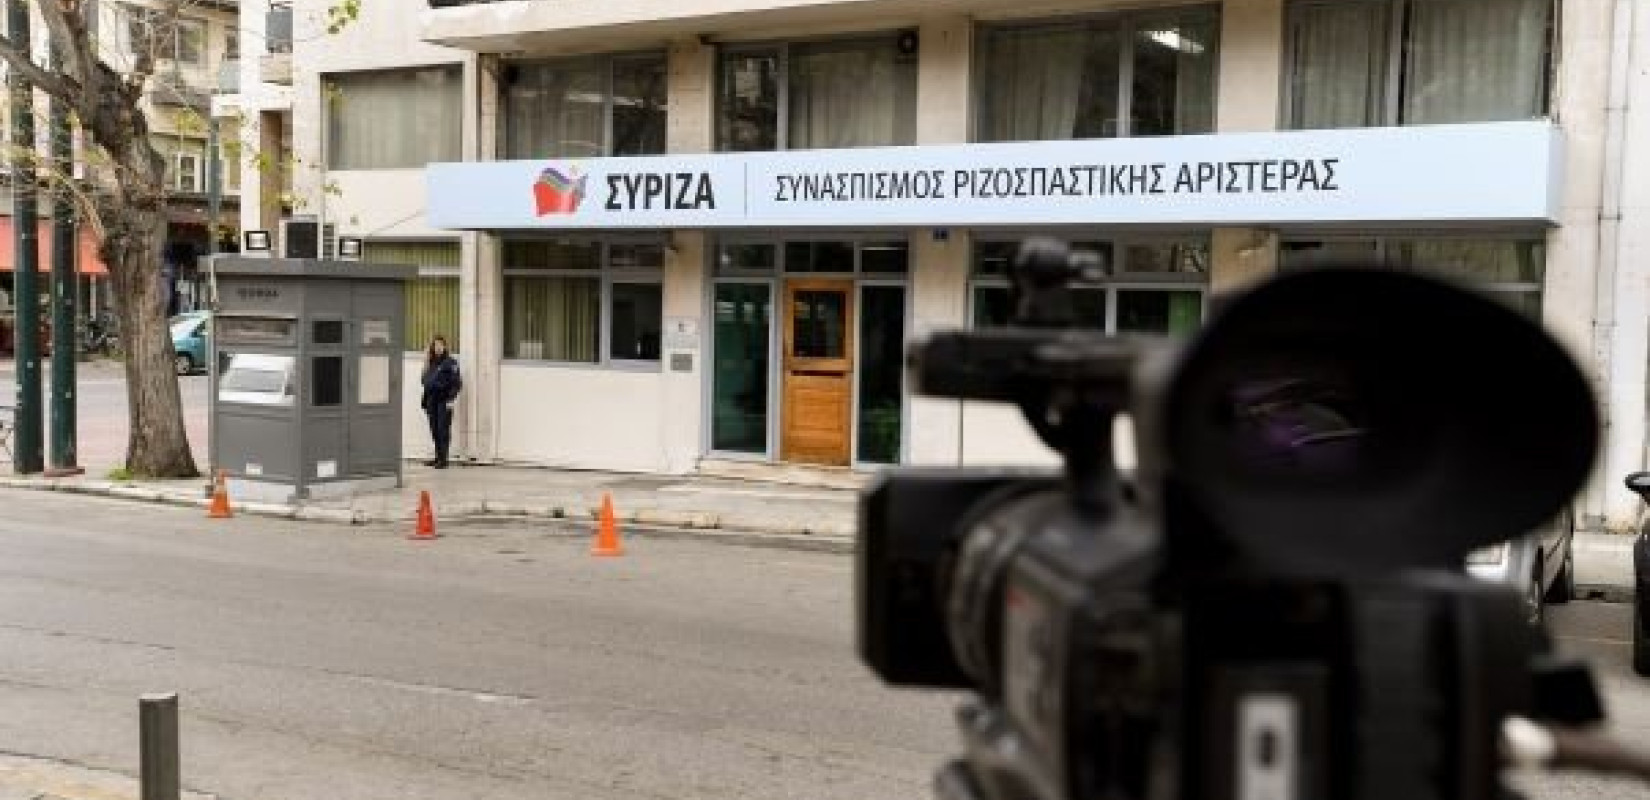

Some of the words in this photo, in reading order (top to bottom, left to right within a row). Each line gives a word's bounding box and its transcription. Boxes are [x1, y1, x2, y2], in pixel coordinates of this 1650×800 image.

[605, 173, 716, 210] ΣΥΡΙΖΑ
[775, 170, 946, 202] ΣΥΝΑΣΠΙΣΜΟΣ
[954, 164, 1167, 199] ΡΙΖΟΣΠΑΣΤΙΚΗΣ
[1173, 158, 1339, 193] ΑΡΙΣΤΕΡΑΣ
